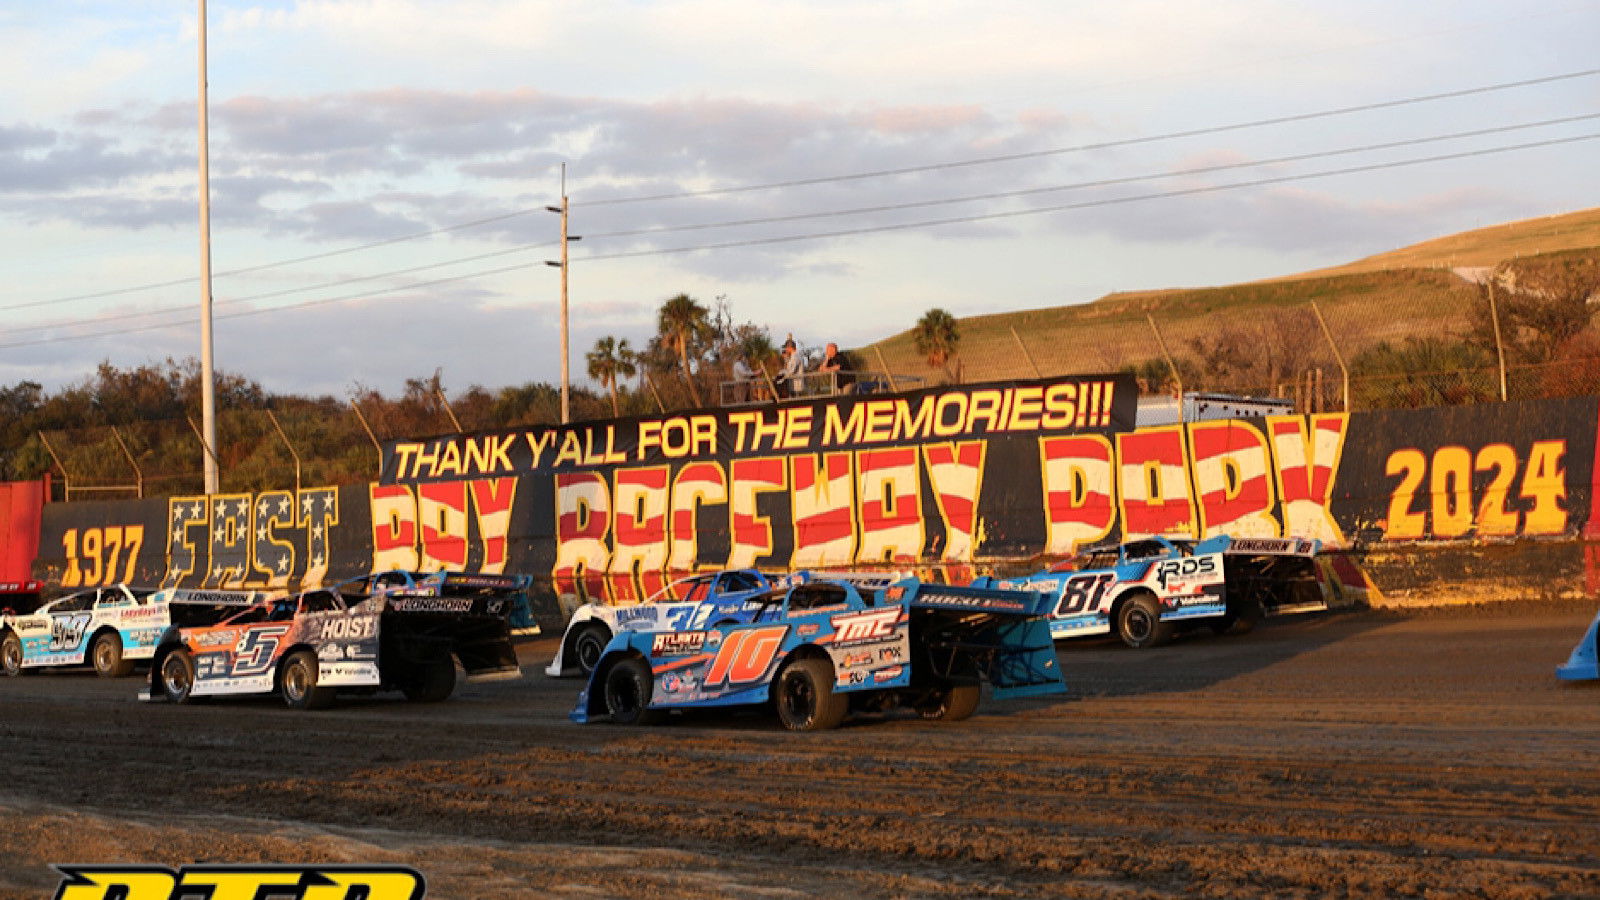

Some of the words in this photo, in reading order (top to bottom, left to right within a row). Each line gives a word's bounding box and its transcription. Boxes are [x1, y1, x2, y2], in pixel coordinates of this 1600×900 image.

[395, 433, 516, 478] THANK
[525, 425, 627, 469] Y'ALL
[638, 415, 716, 460] FOR
[727, 407, 811, 452] THE
[821, 381, 1114, 446] MEMORIES!!!
[60, 525, 143, 588] 1977
[553, 439, 987, 600] RACEWAY
[1039, 412, 1356, 565] PARK
[1384, 438, 1567, 540] 2024
[320, 616, 374, 639] HOIST
[830, 606, 903, 642] TMC
[703, 625, 789, 688] 10
